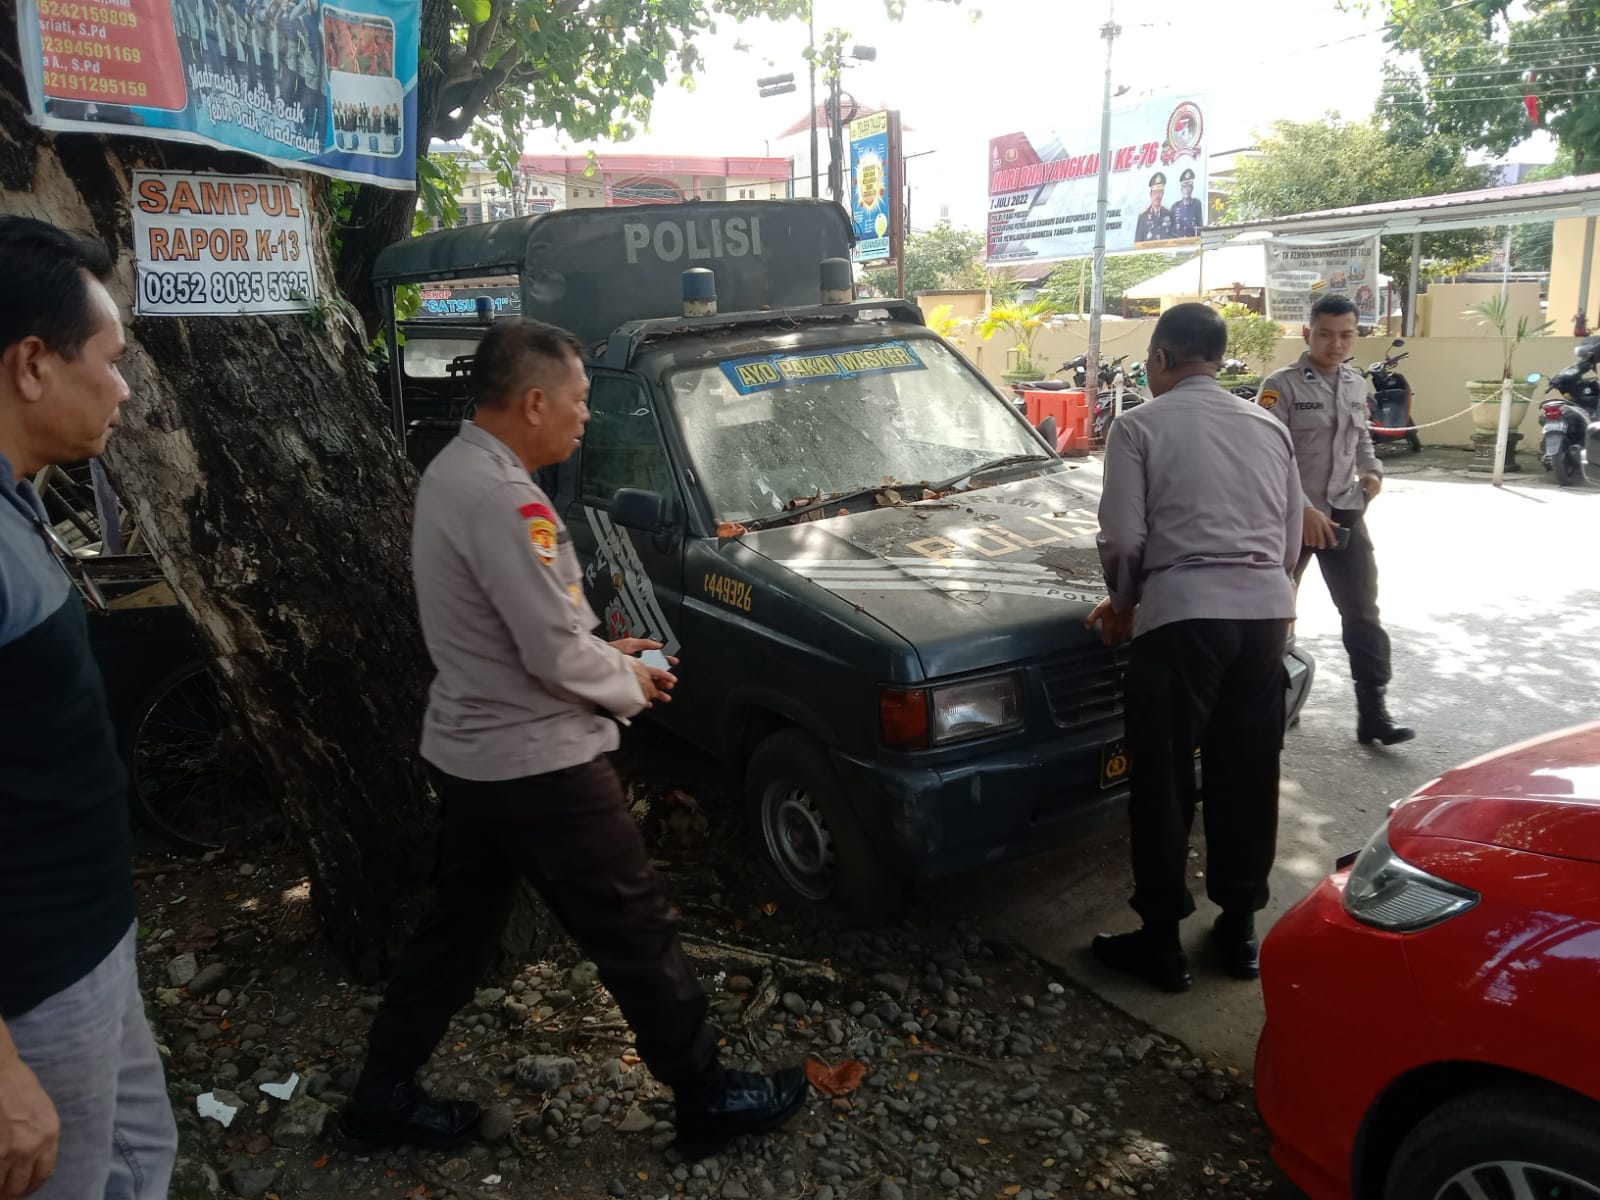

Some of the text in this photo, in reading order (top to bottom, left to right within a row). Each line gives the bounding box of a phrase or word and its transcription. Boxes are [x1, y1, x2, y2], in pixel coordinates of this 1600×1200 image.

[80, 23, 106, 39] S.Pd
[72, 57, 100, 74] S.Pd
[189, 64, 239, 97] Madrasah
[240, 79, 273, 113] Lebih
[206, 95, 320, 155] Lebih Baik Madrasah
[992, 168, 1020, 192] HARI
[1114, 142, 1160, 171] KE-76
[138, 179, 300, 217] SAMPUL
[994, 197, 1011, 209] JULI
[1010, 194, 1029, 207] 2022
[149, 228, 299, 261] RAPOR K-13
[624, 216, 762, 264] POLISI
[145, 271, 311, 304] 0852 8035 5625
[737, 347, 914, 386] AYO PAKAI MASKER
[1295, 402, 1324, 411] TEGUH
